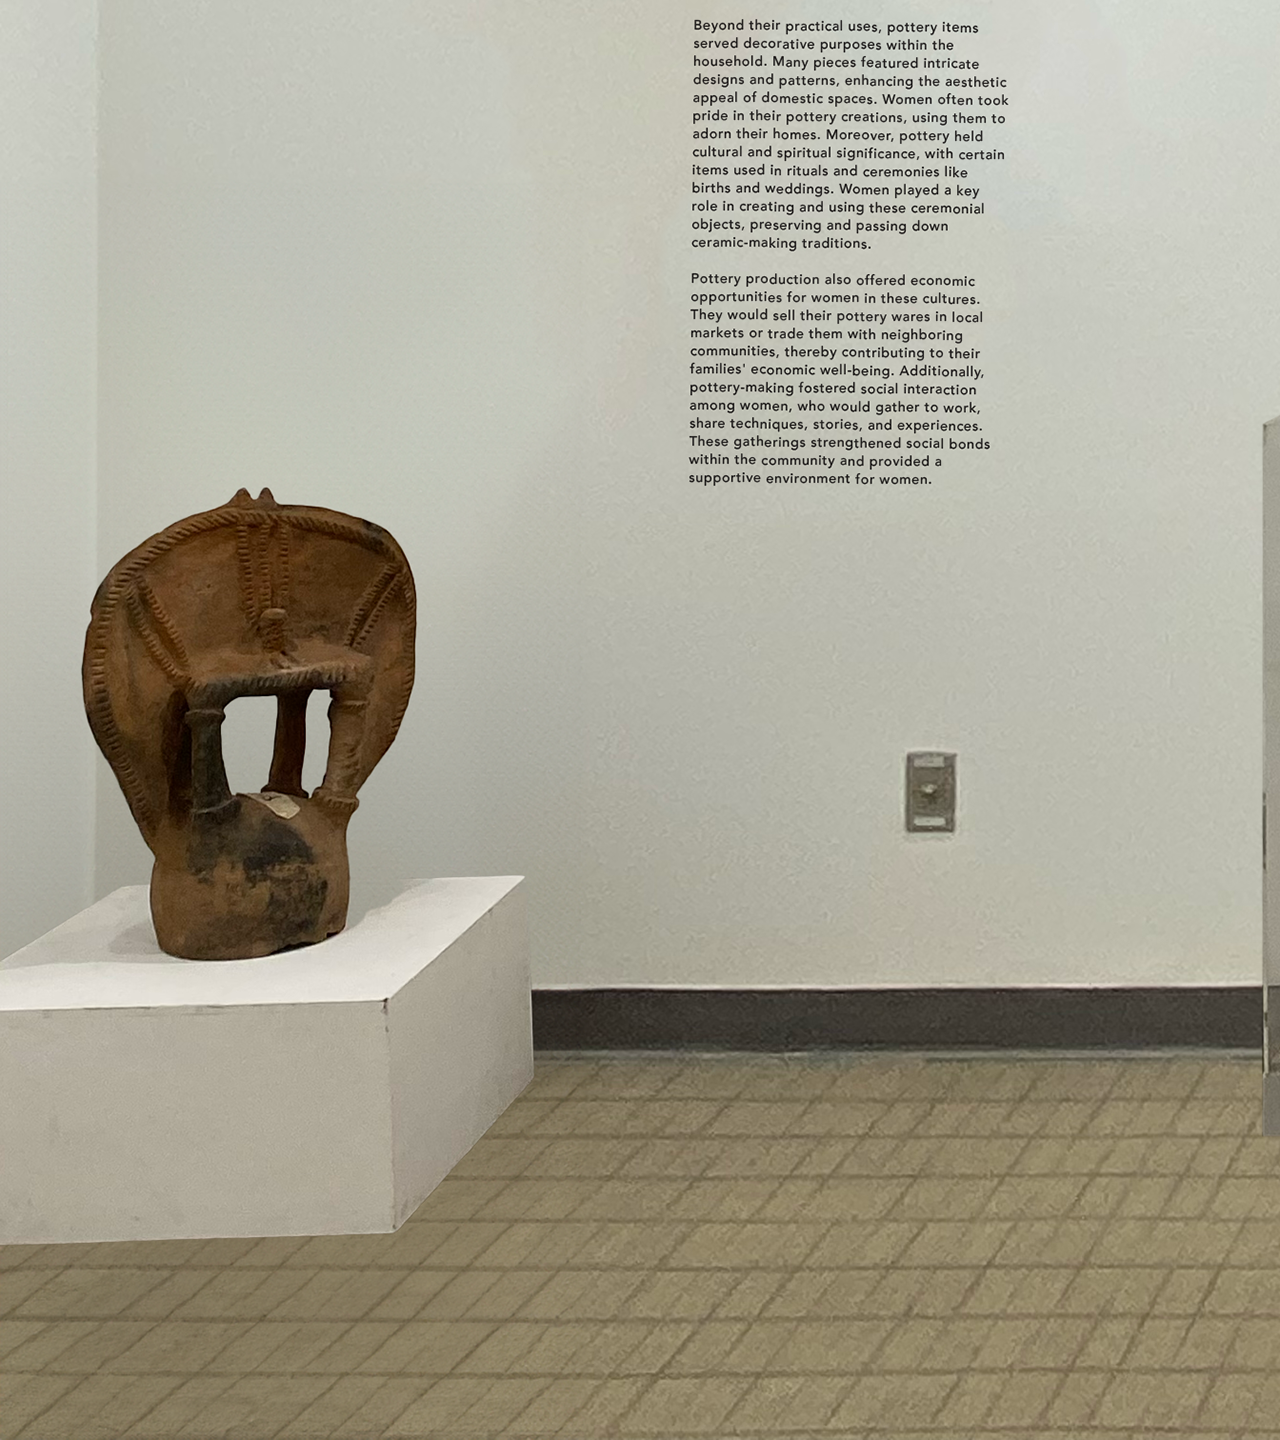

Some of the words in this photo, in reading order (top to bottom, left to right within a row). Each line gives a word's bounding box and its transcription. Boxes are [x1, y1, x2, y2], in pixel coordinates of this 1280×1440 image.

[693, 18, 745, 34] Beyond
[748, 18, 781, 31] their
[785, 19, 843, 36] practical
[848, 22, 882, 34] uses,
[887, 22, 938, 36] pottery
[942, 21, 979, 34] items
[691, 272, 742, 288] Pottery
[745, 272, 820, 288] production
[824, 272, 852, 285] also
[856, 273, 906, 286] offered
[910, 275, 976, 287] economic
[689, 361, 746, 375] families'
[750, 364, 816, 376] economic
[819, 363, 895, 380] well-being.
[898, 364, 985, 381] Additionally,
[688, 471, 762, 487] supportive
[765, 472, 851, 485] environment
[854, 472, 876, 485] for
[878, 476, 932, 485] women.
